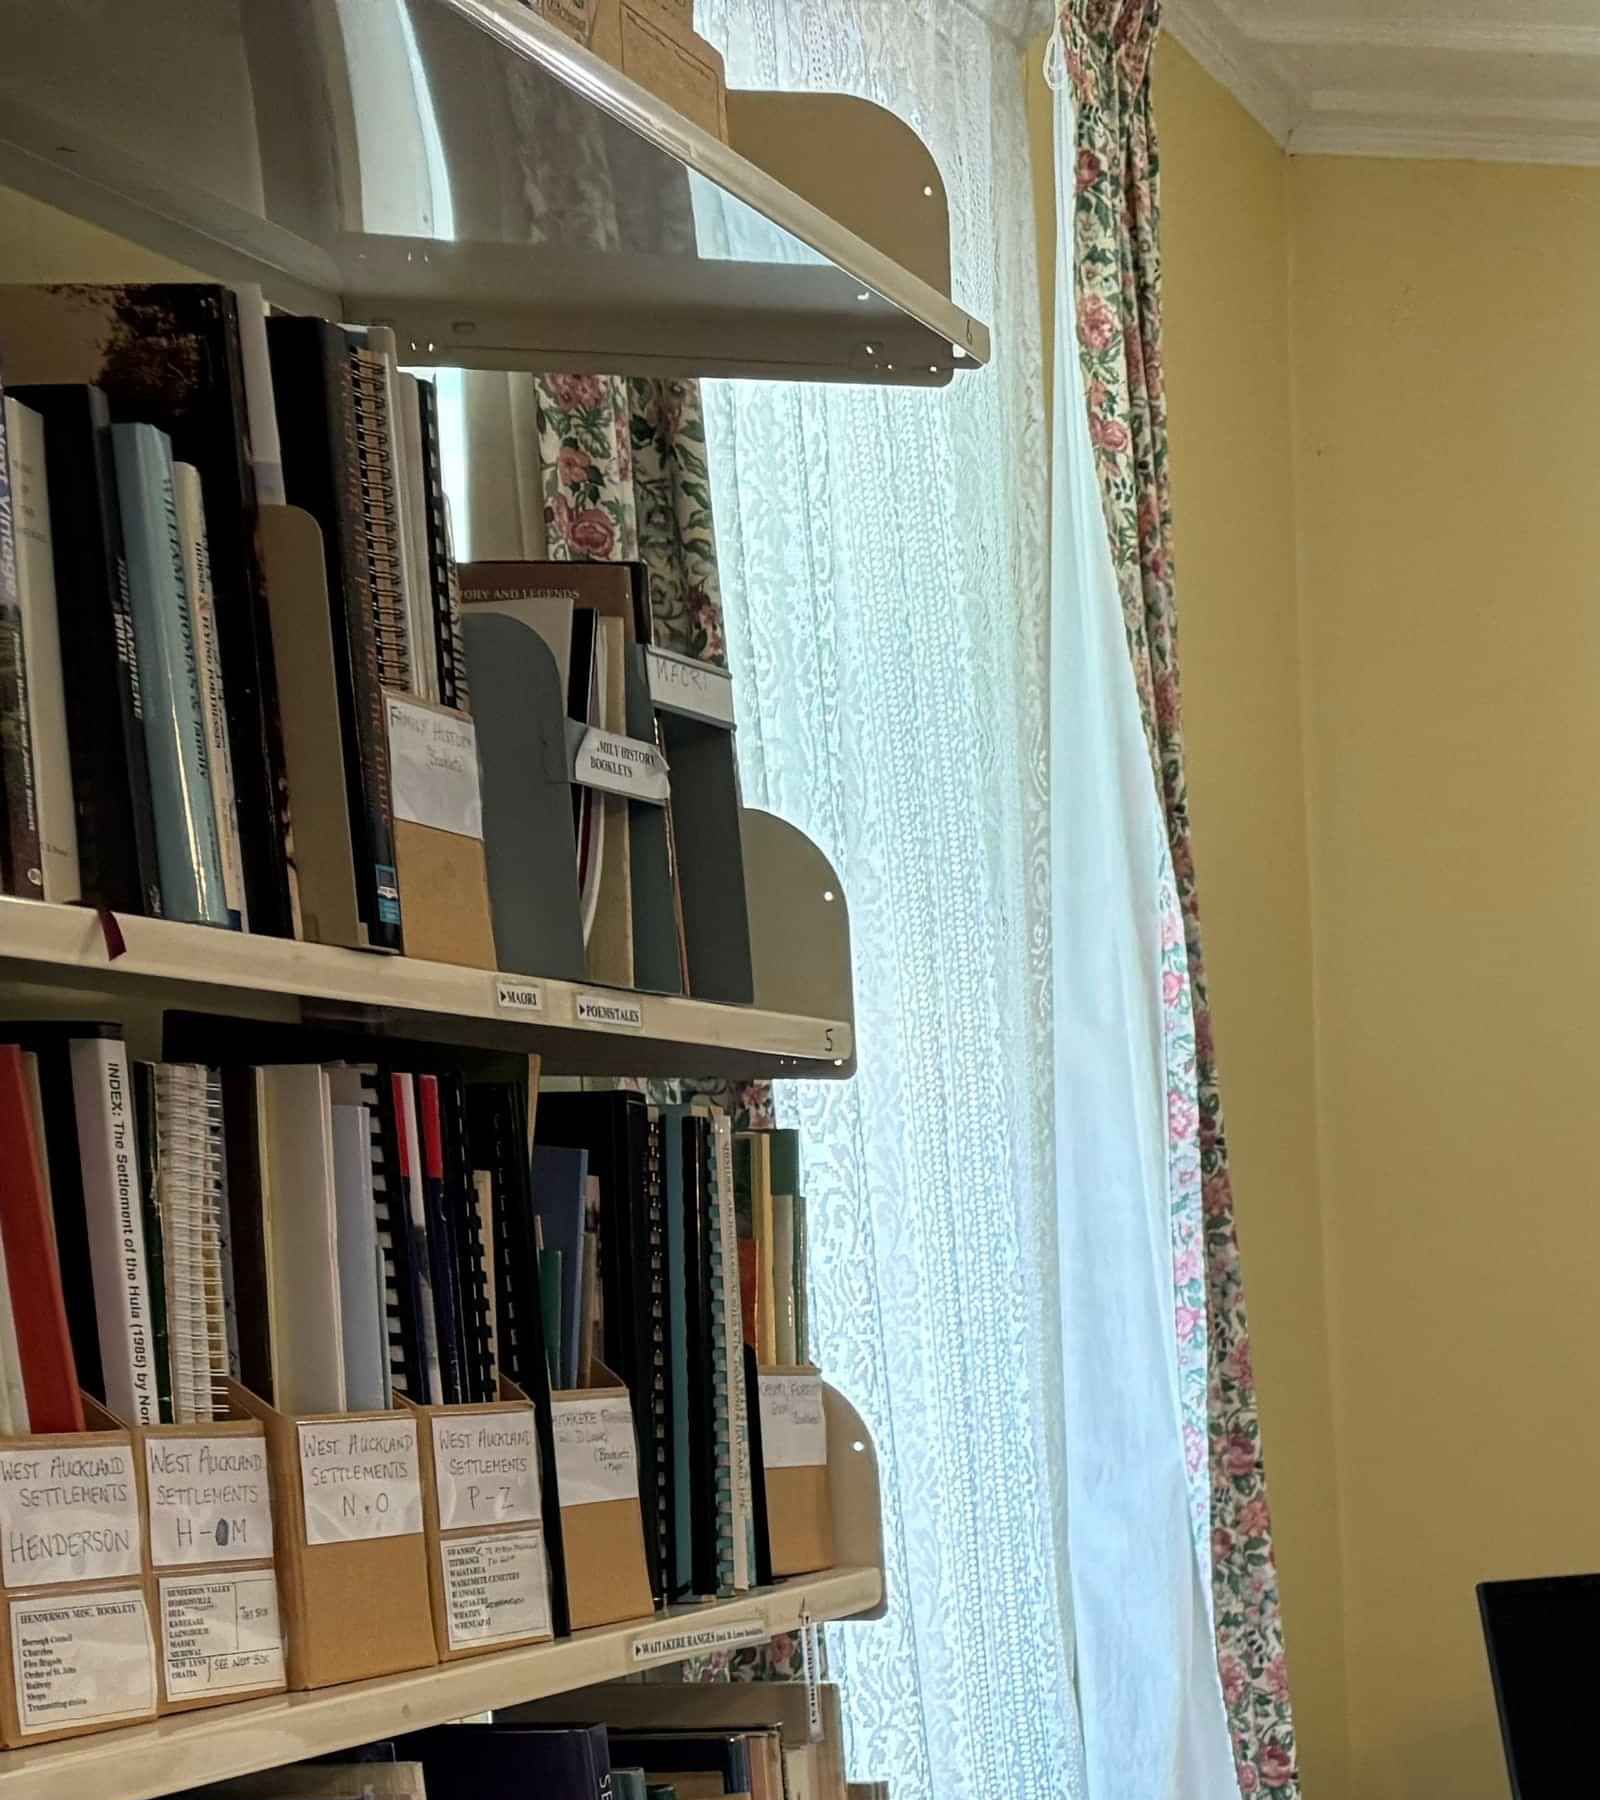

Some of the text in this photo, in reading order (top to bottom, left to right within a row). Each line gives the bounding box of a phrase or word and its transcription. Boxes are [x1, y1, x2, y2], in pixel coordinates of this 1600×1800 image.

[590, 756, 632, 778] BOOKLETS
[507, 991, 536, 1006] MAORI
[107, 1061, 121, 1117] INDEX:
[114, 1121, 126, 1150] The
[116, 1154, 134, 1235] Settlement
[126, 1257, 137, 1282] the
[134, 1372, 148, 1391] by
[303, 1433, 414, 1457] WEST AUCKLAND
[440, 1432, 473, 1452] WEST
[1, 1456, 124, 1481] WEST AUCKLAND
[150, 1446, 263, 1475] WEST AUCKLAND
[450, 1457, 528, 1476] SETTLEMENTS
[312, 1462, 408, 1486] SETTLEMENTS
[19, 1484, 127, 1507] SETTLEMENTS
[157, 1485, 258, 1505] SETTLEMENTS
[10, 1528, 129, 1563] HENDERSON
[20, 1607, 70, 1624] HENDERSON
[97, 1603, 137, 1617] BOOKLETS
[642, 1636, 685, 1655] WAITAKERE
[686, 1632, 715, 1647] RANGES
